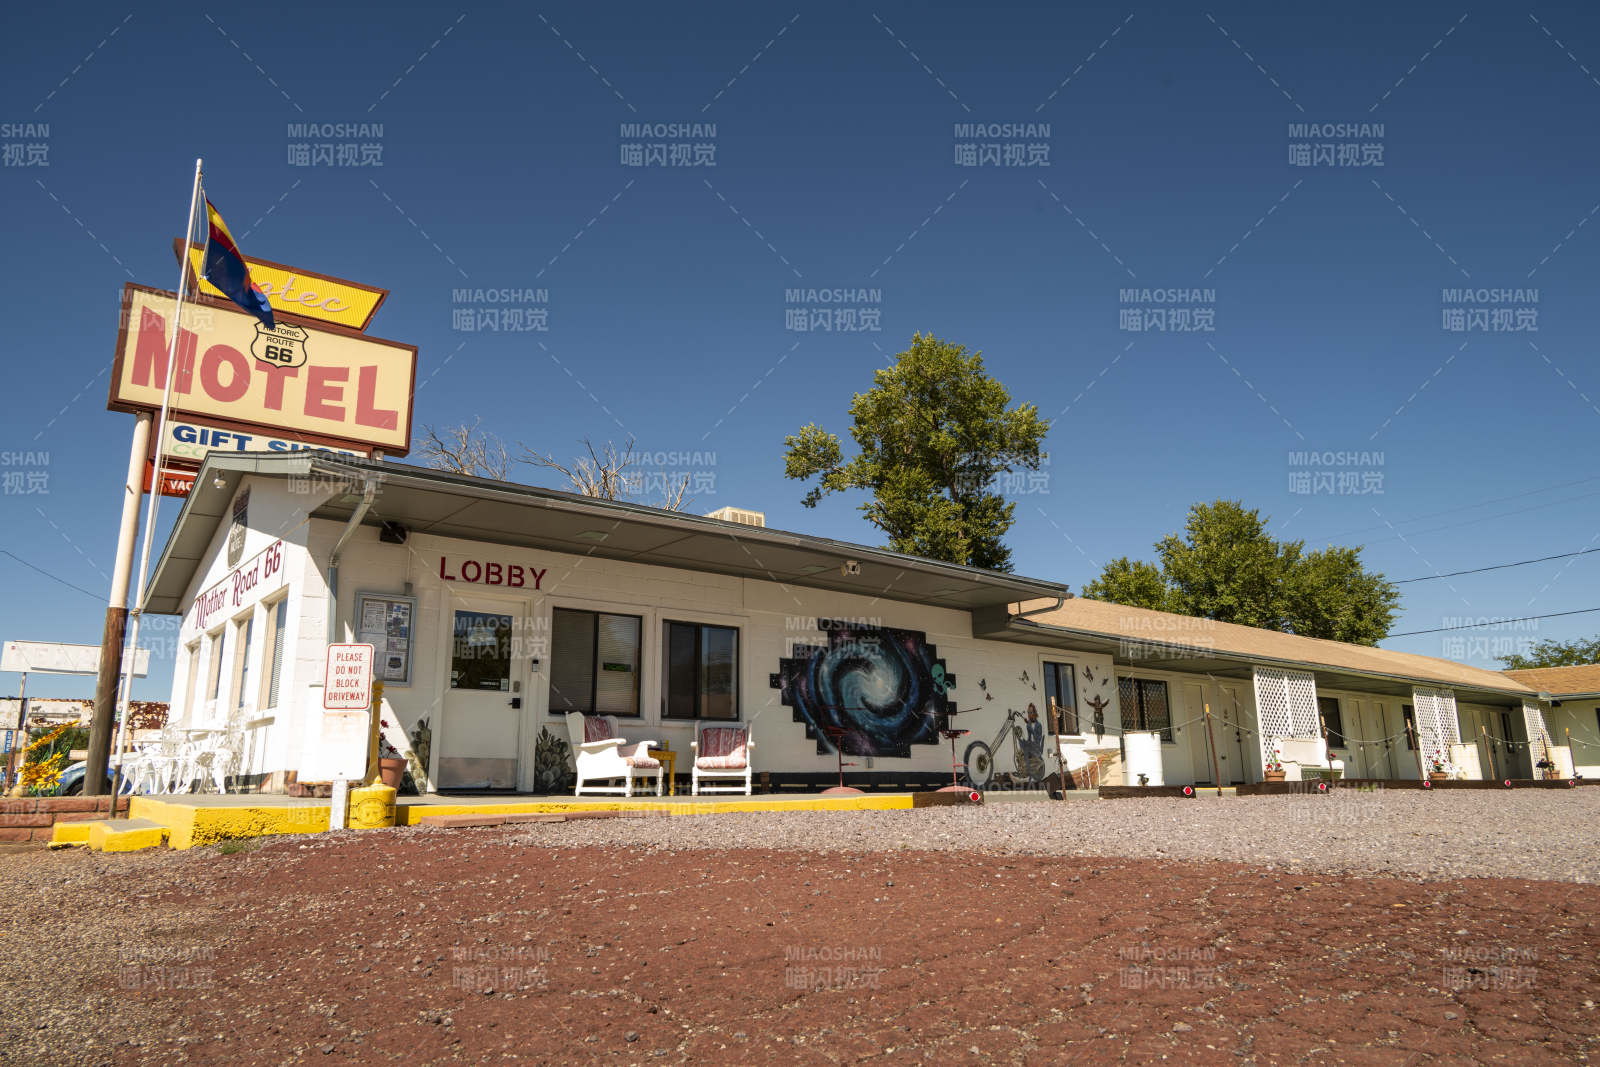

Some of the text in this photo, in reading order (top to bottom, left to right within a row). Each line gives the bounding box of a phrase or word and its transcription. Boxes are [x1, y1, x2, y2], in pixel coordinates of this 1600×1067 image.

[266, 336, 295, 348] ROUTE
[265, 345, 293, 363] 66
[131, 304, 399, 431] MOTEL
[173, 424, 253, 451] GIFT
[439, 556, 547, 590] LOBBY
[194, 541, 283, 630] Mother Road 66
[336, 652, 363, 662] PLEASE
[335, 665, 362, 675] DO NOT
[336, 679, 359, 687] BLOCK
[328, 691, 365, 701] DRIVEWAY
